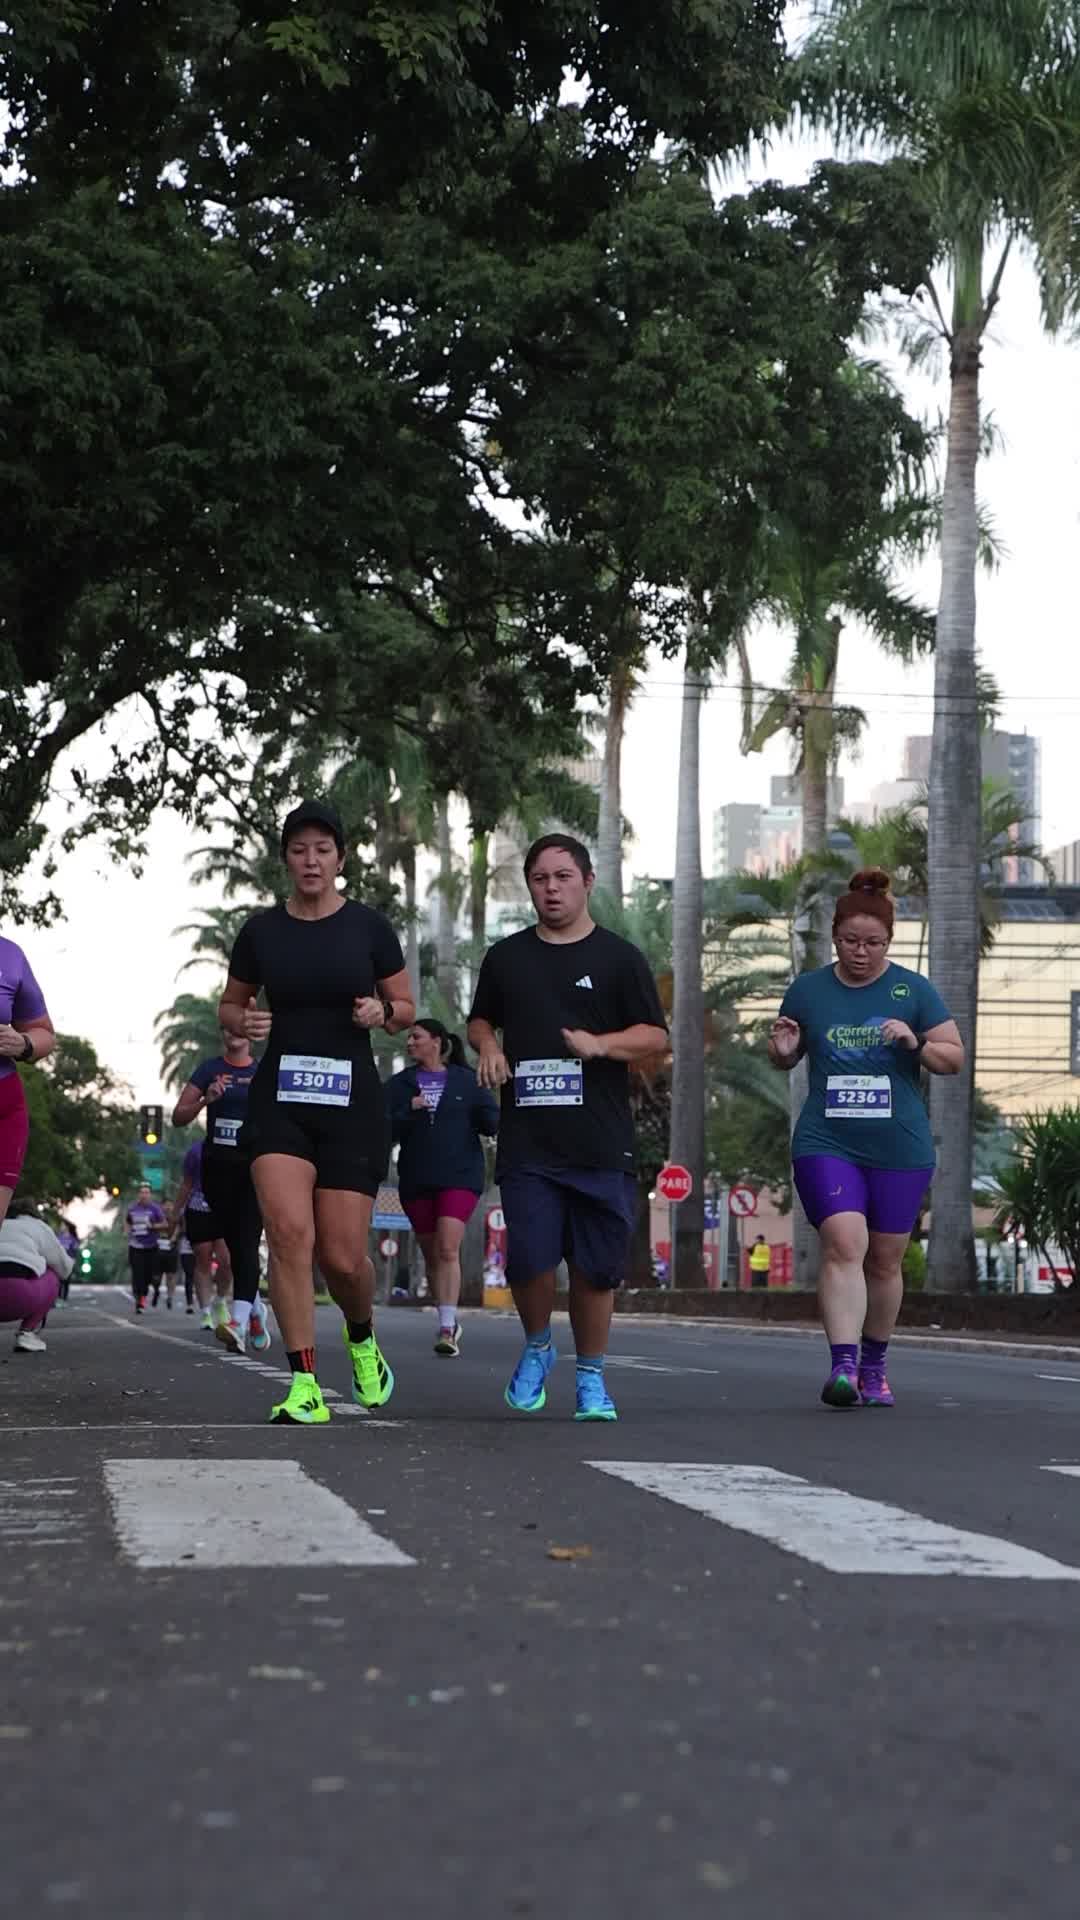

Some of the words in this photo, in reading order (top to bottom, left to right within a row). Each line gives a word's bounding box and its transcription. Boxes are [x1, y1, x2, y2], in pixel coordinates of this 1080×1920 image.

[836, 1025, 873, 1037] Correr
[292, 1072, 334, 1088] 5301
[526, 1076, 566, 1091] 5656
[837, 1091, 877, 1104] 5236
[660, 1178, 688, 1189] PARE
